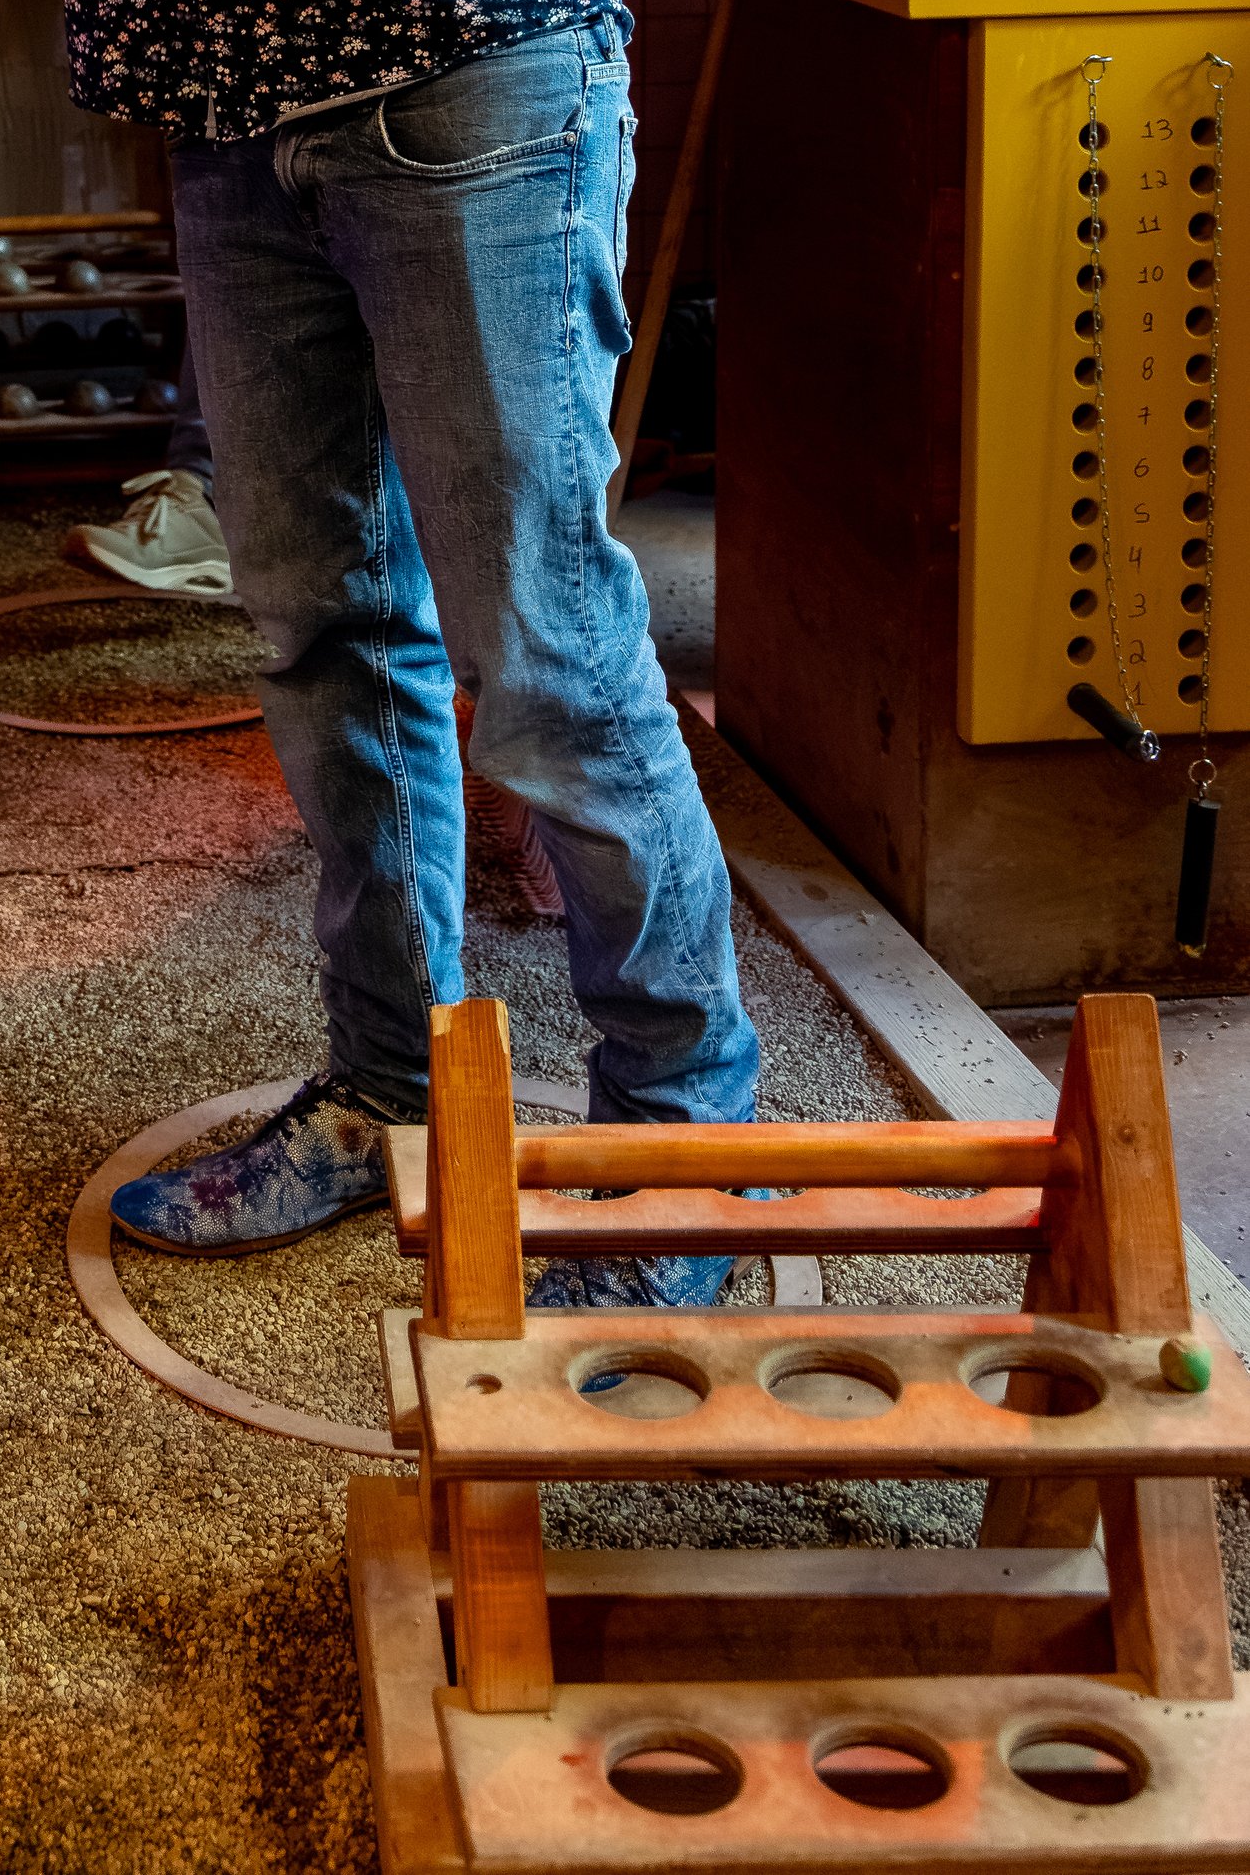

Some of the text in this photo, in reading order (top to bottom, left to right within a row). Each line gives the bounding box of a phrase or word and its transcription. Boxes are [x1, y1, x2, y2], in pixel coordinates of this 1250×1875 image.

[1140, 117, 1174, 141] 13
[1140, 169, 1169, 191] 12
[1136, 215, 1163, 235] 11
[1137, 265, 1165, 284] 10
[1142, 312, 1154, 333] 9
[1141, 356, 1155, 381] 8
[1137, 406, 1151, 425] 7
[1133, 457, 1150, 478] 6
[1133, 502, 1151, 524] 5
[1128, 545, 1143, 570] 4
[1128, 593, 1148, 618] 3
[1128, 639, 1148, 665] 2
[1130, 681, 1146, 706] 1
